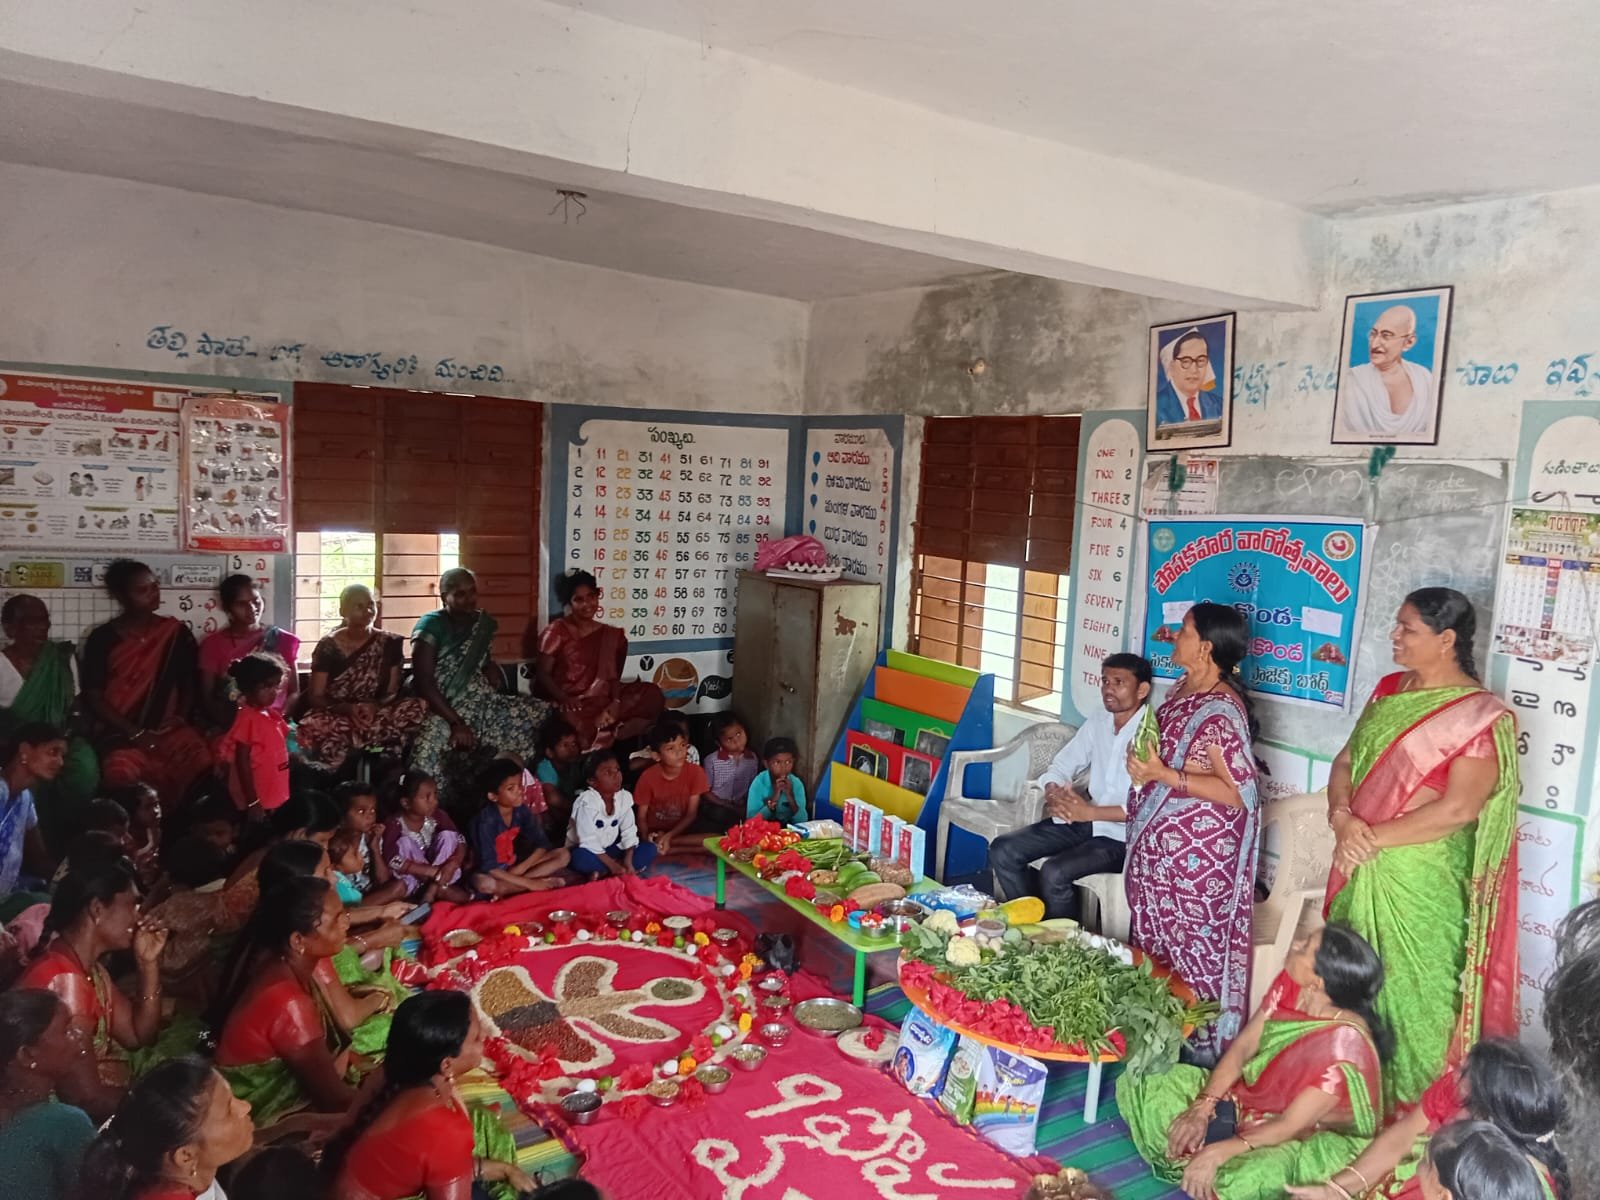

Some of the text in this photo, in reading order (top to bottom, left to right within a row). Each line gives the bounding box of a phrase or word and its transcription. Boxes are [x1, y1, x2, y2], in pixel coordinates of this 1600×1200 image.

[577, 448, 769, 469] 1 11 21 31 41 51 61 71 81 91
[1097, 448, 1133, 458] ONE 1
[574, 466, 772, 487] 2 12 22 32 42 52 62 72 82 92
[1095, 469, 1132, 480] TWO 2
[572, 485, 770, 507] 3 13 23 33 43 53 63 73 83 93
[1091, 492, 1130, 505] THREE 3
[574, 504, 770, 526] 4 14 24 34 44 54 64 74 84 94
[1091, 517, 1127, 531] FOUR 4
[1549, 516, 1587, 532] TGTTF
[573, 528, 581, 541] 5
[594, 528, 606, 541] 15
[613, 528, 629, 541] 25
[635, 531, 651, 543] 35
[656, 531, 669, 543] 45
[676, 532, 690, 543] 55
[696, 532, 710, 542] 65
[718, 533, 730, 543] 75
[736, 533, 750, 544] 85
[571, 548, 581, 559] 6
[594, 548, 606, 560] 16
[613, 549, 628, 561] 26
[633, 550, 649, 561] 36
[656, 549, 668, 560] 46
[676, 551, 690, 561] 56
[695, 551, 710, 561] 66
[716, 553, 728, 563] 76
[735, 552, 749, 562] 86
[1089, 544, 1124, 558] FIVE 5
[593, 567, 605, 579] 17
[612, 568, 627, 580] 27
[633, 568, 649, 580] 37
[655, 568, 667, 580] 47
[675, 569, 689, 580] 57
[693, 569, 706, 579] 67
[714, 569, 729, 580] 77
[1088, 568, 1121, 583] SIX 6
[610, 587, 626, 600] 28
[632, 588, 648, 600] 38
[655, 587, 667, 598] 48
[673, 587, 688, 599] 58
[693, 588, 705, 598] 68
[714, 588, 728, 599] 78
[1085, 593, 1122, 612] SEVEN 7
[609, 608, 624, 619] 29
[631, 607, 648, 618] 39
[653, 605, 666, 617] 49
[673, 606, 686, 619] 59
[691, 607, 704, 617] 69
[713, 607, 727, 617] 79
[630, 624, 645, 636] 40
[653, 624, 667, 636] 50
[672, 624, 685, 635] 60
[692, 624, 704, 635] 70
[713, 622, 727, 634] 80
[1083, 618, 1119, 637] EIGHT 8
[1084, 644, 1107, 661] NINE
[1083, 671, 1101, 686] TEN
